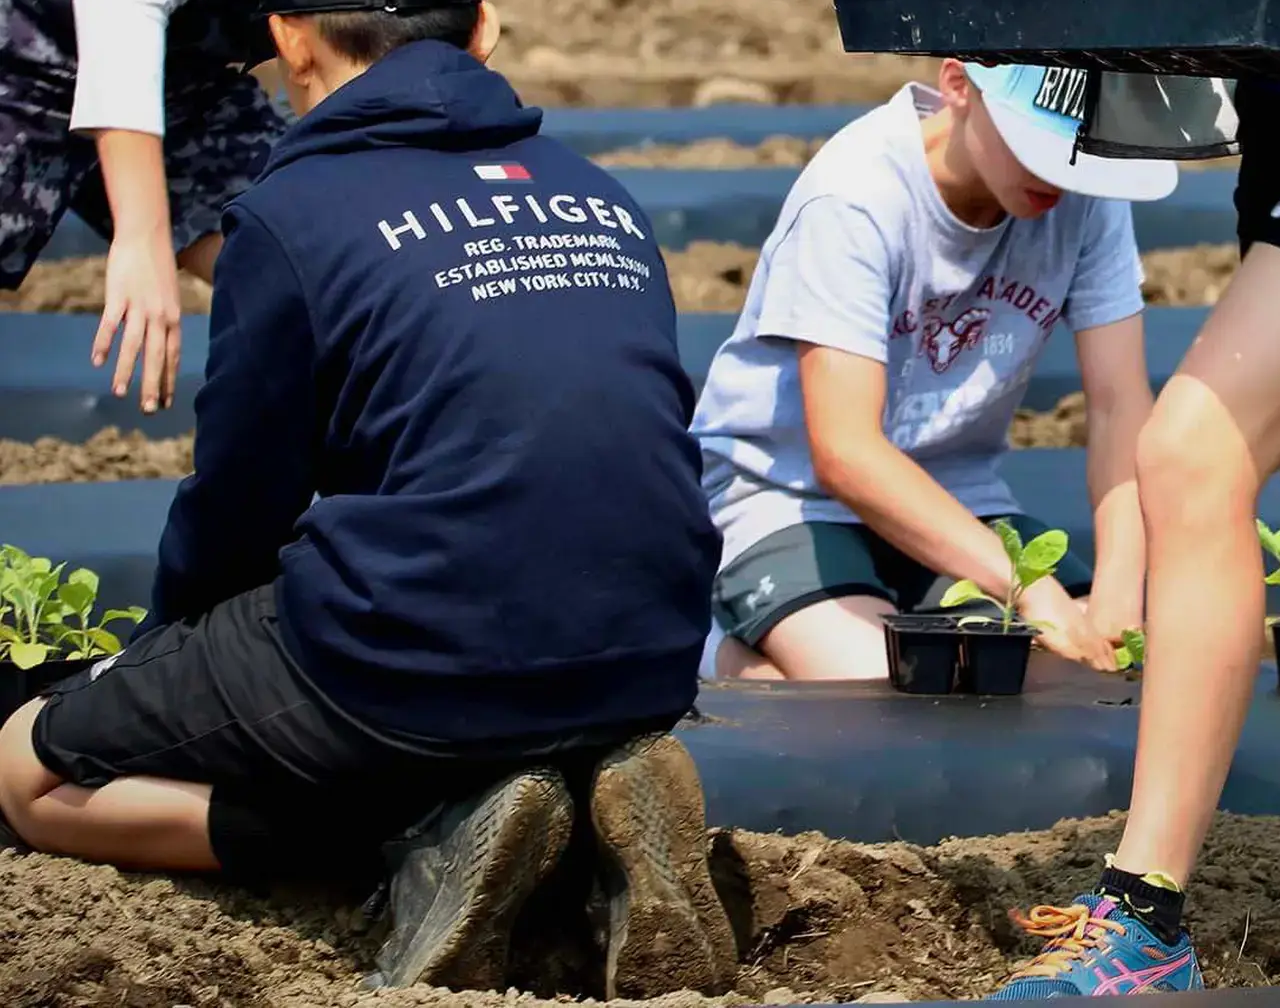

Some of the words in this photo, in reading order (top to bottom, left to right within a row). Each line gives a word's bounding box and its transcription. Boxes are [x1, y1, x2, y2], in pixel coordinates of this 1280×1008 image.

[378, 193, 645, 251] HILFIGER
[463, 236, 512, 257] REG.
[512, 234, 621, 251] TRADEMARK
[434, 254, 568, 288] ESTABLISHED
[471, 278, 516, 302] NEW
[520, 273, 571, 293] YORK
